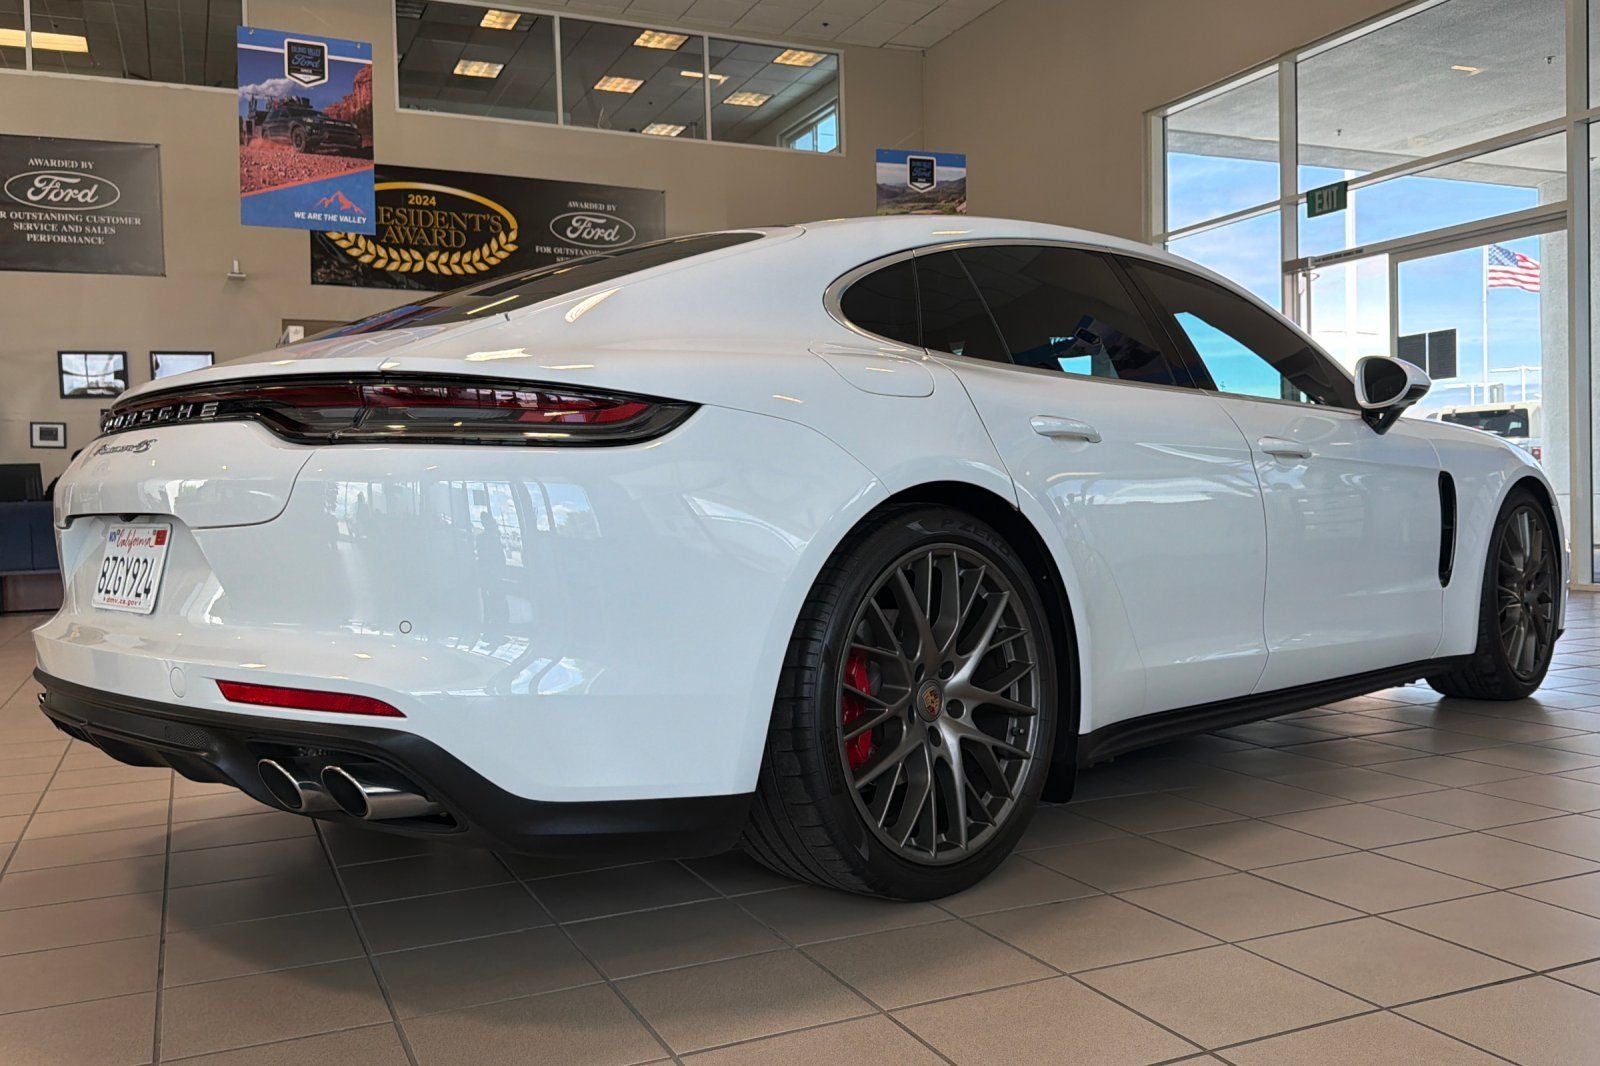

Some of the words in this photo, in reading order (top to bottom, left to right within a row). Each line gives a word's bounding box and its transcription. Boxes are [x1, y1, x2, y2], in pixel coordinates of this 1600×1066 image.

[291, 54, 321, 68] Ford
[28, 158, 78, 169] AWARDED
[80, 160, 94, 170] BY
[27, 174, 99, 203] Ford
[407, 193, 437, 207] 2024
[567, 200, 606, 211] AWARDED
[606, 203, 618, 212] BY
[1314, 186, 1339, 214] EXIT
[9, 211, 83, 223] OUTSTANDING
[86, 214, 141, 225] CUSTOMER
[294, 211, 306, 219] WE
[307, 212, 322, 221] ARE
[323, 213, 338, 222] THE
[339, 215, 367, 224] VALLEY
[377, 205, 502, 233] ESIDENT'S
[13, 222, 58, 232] SERVICE
[62, 225, 83, 233] AND
[84, 226, 116, 235] SALES
[566, 215, 620, 241] Ford
[26, 233, 105, 245] PERFORMANCE
[380, 225, 467, 249] AWARD
[535, 245, 552, 254] FOR
[103, 401, 219, 434] PORSCHE
[116, 527, 155, 555] California
[97, 556, 155, 599] 8ZGY924
